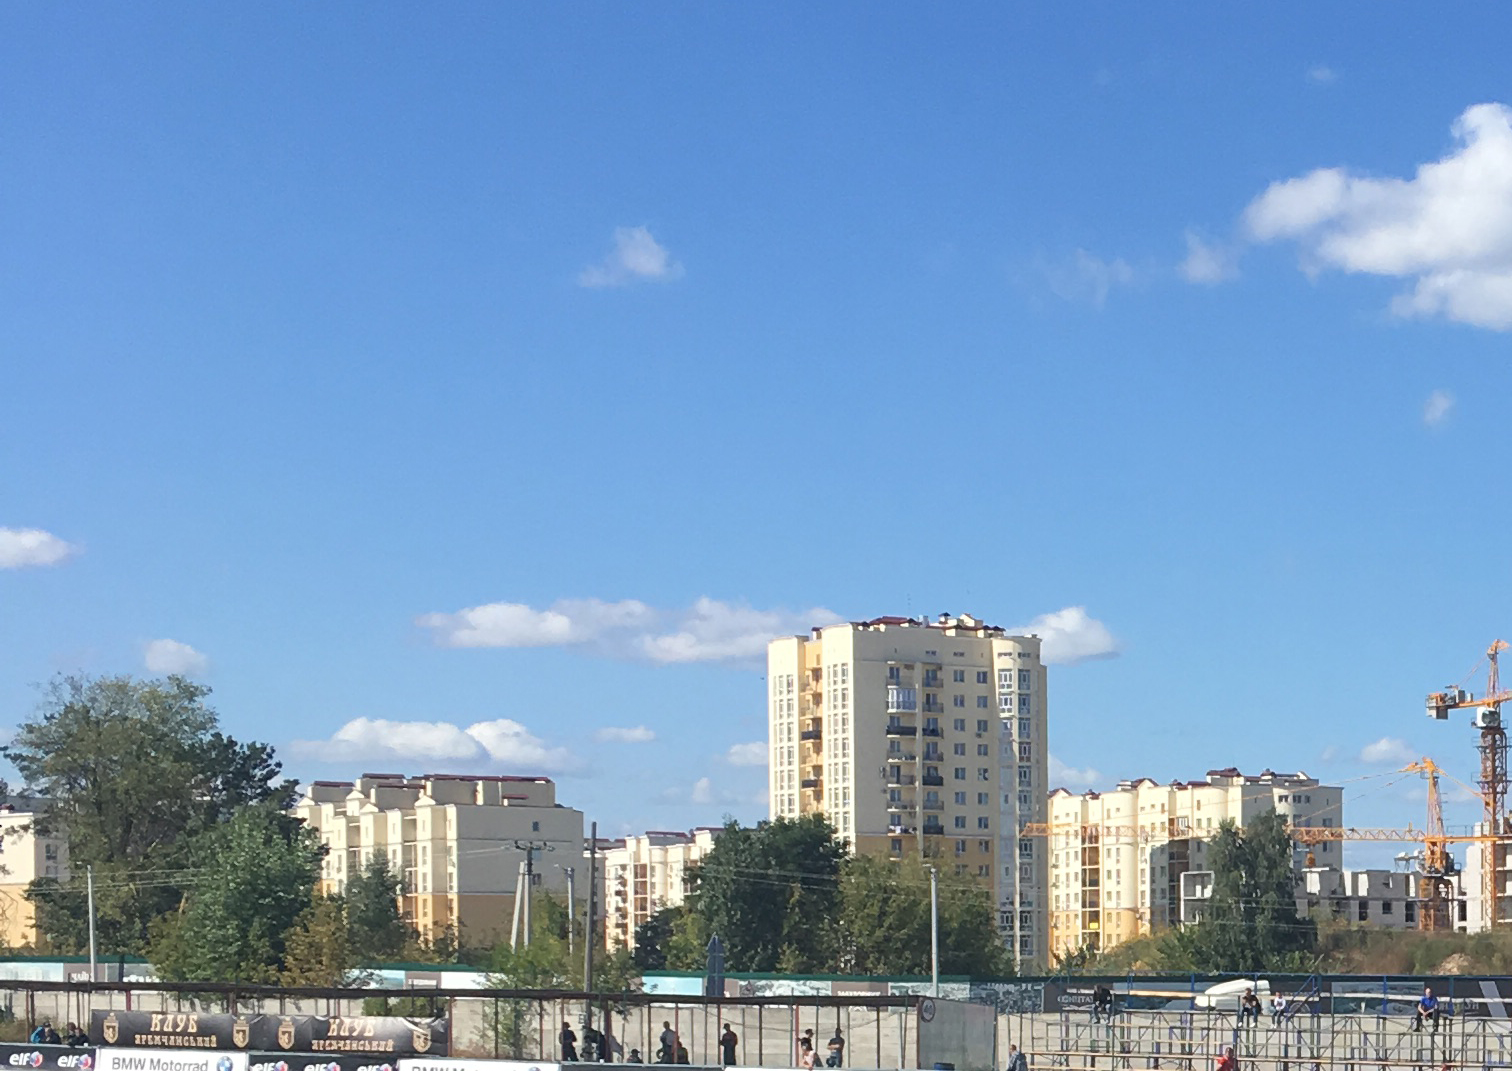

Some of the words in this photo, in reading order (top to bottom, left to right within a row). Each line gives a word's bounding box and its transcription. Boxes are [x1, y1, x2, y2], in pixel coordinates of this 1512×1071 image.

[150, 1013, 198, 1033] КЛУБ
[328, 1017, 376, 1037] КЛУБ
[9, 1053, 30, 1066] elf
[58, 1054, 79, 1068] elf
[112, 1057, 146, 1071] BMW
